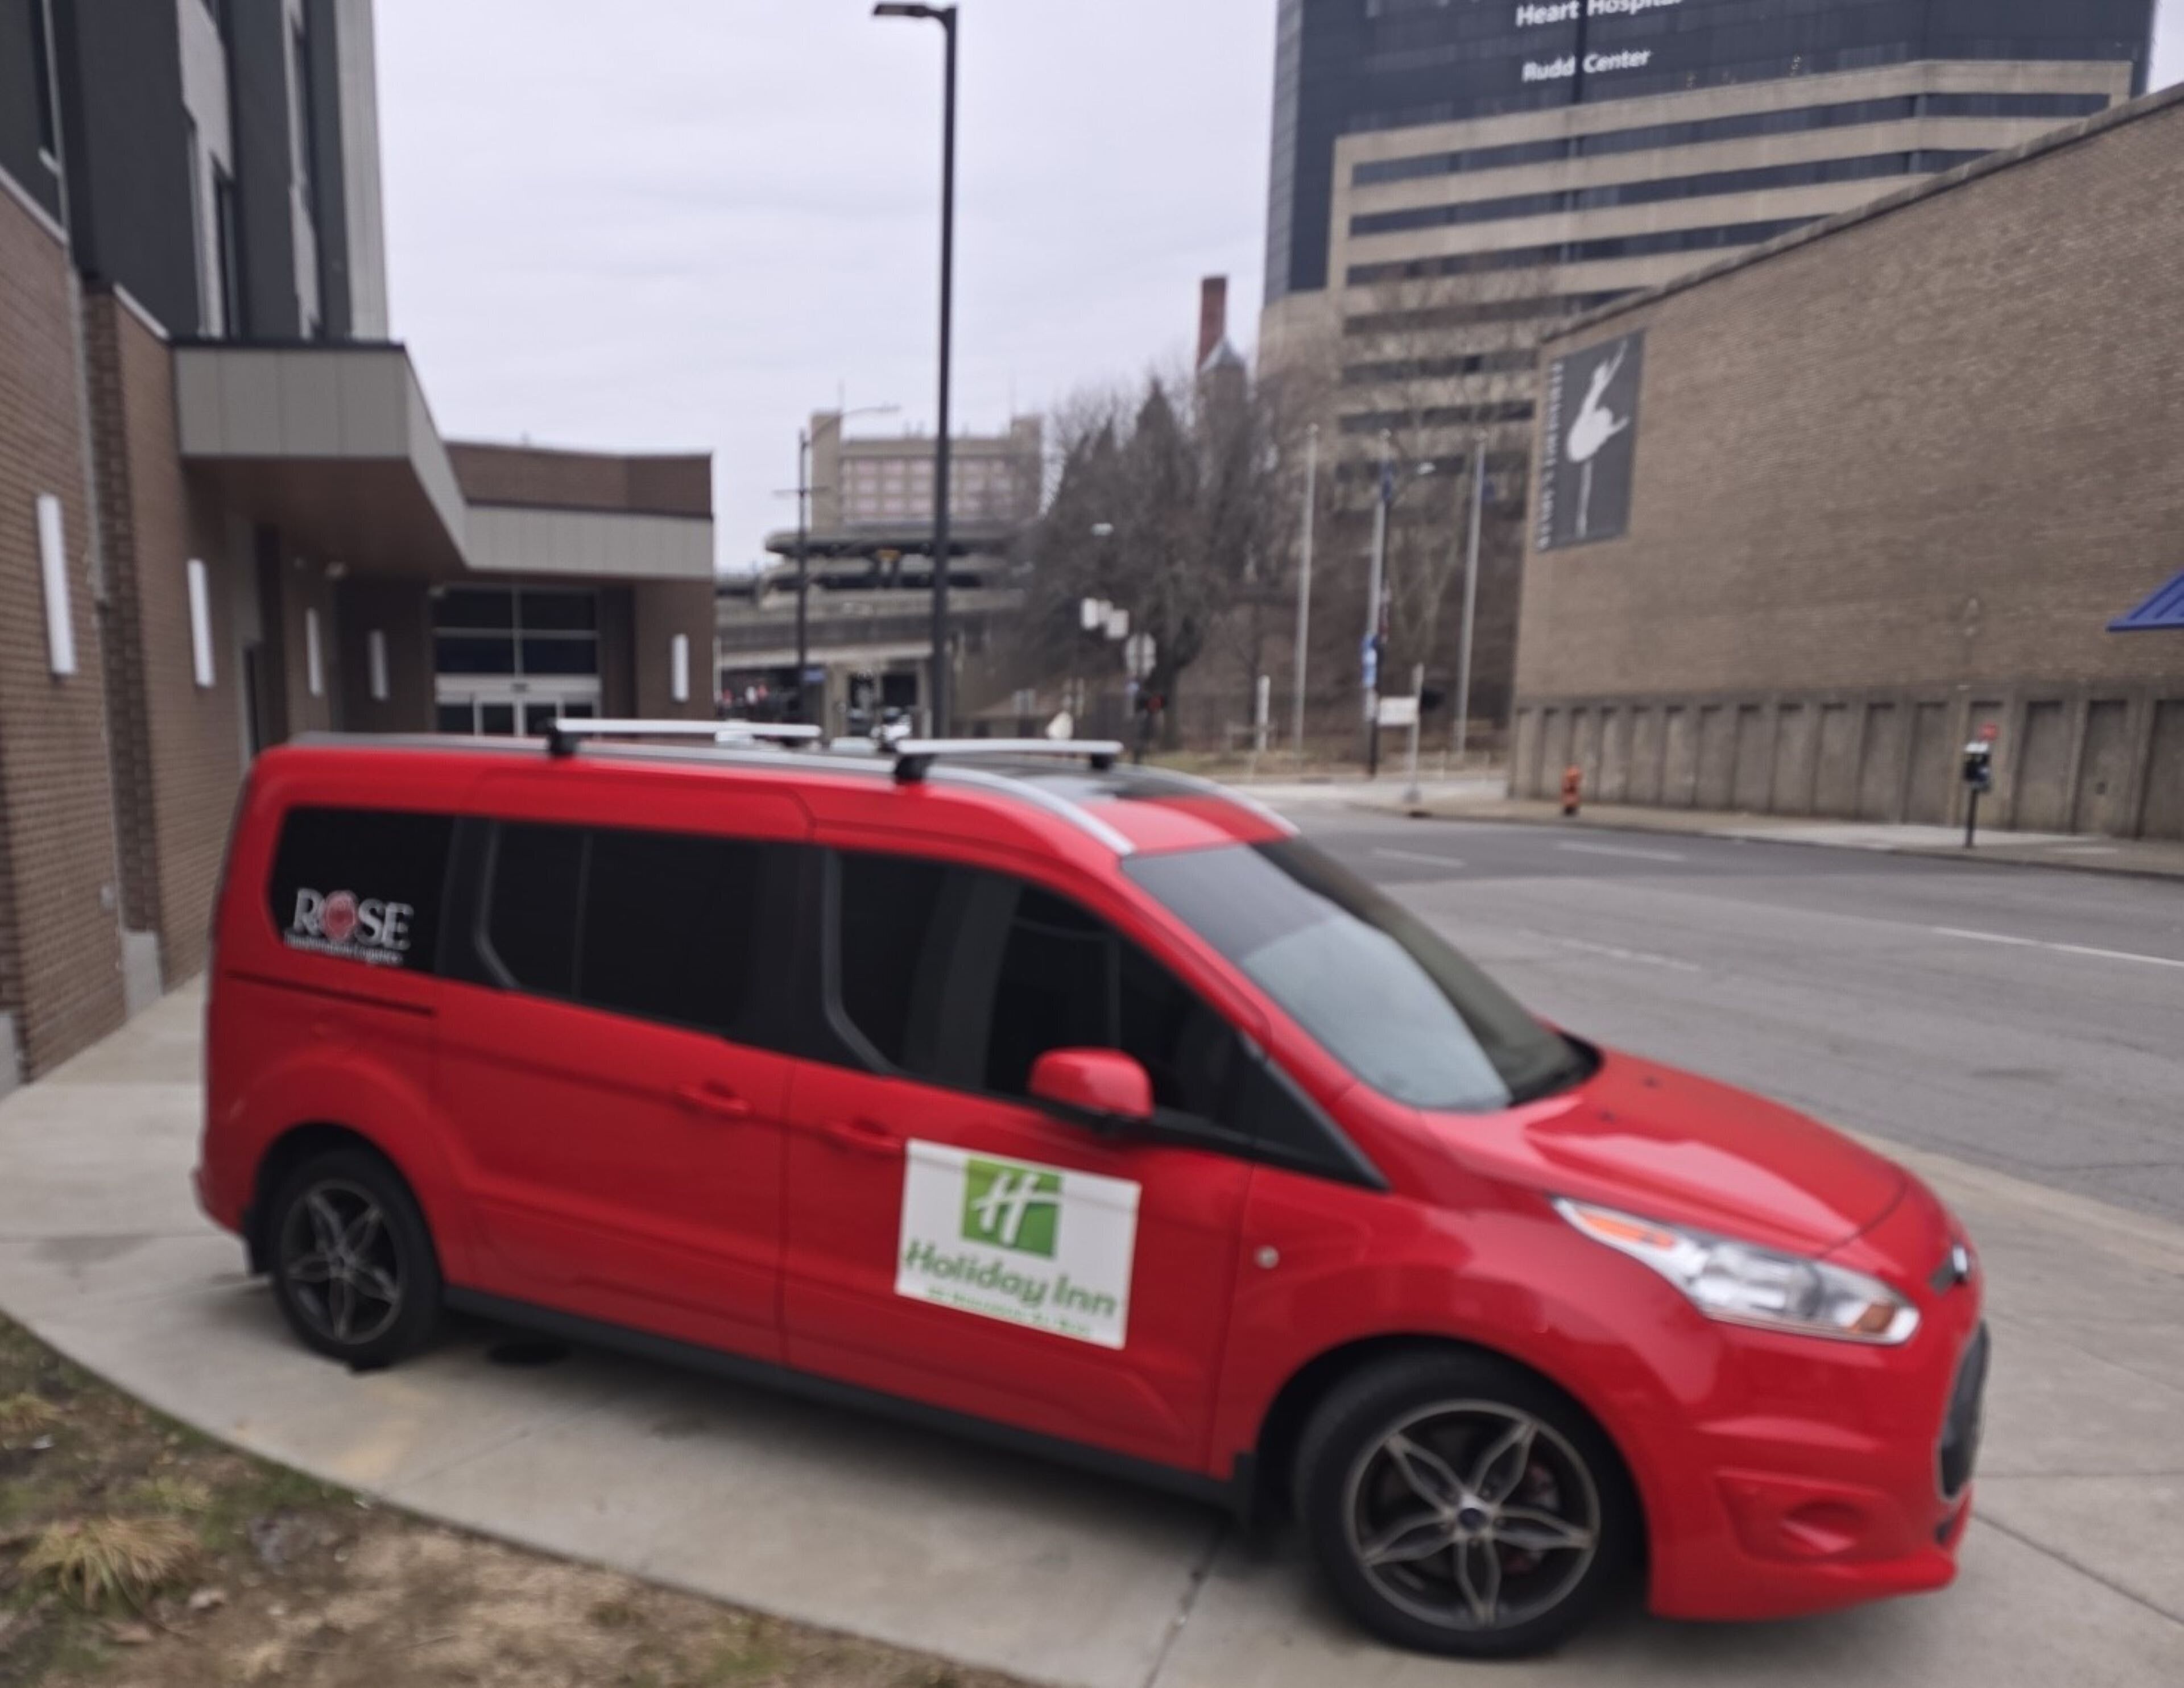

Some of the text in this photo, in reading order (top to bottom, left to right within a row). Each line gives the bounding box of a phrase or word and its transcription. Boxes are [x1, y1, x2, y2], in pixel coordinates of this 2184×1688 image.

[1516, 1, 1579, 27] Heart
[1521, 50, 1652, 82] Rudd Center
[292, 887, 415, 951] ROSE
[905, 1239, 1048, 1308] Holiday
[1052, 1273, 1116, 1317] Inn
